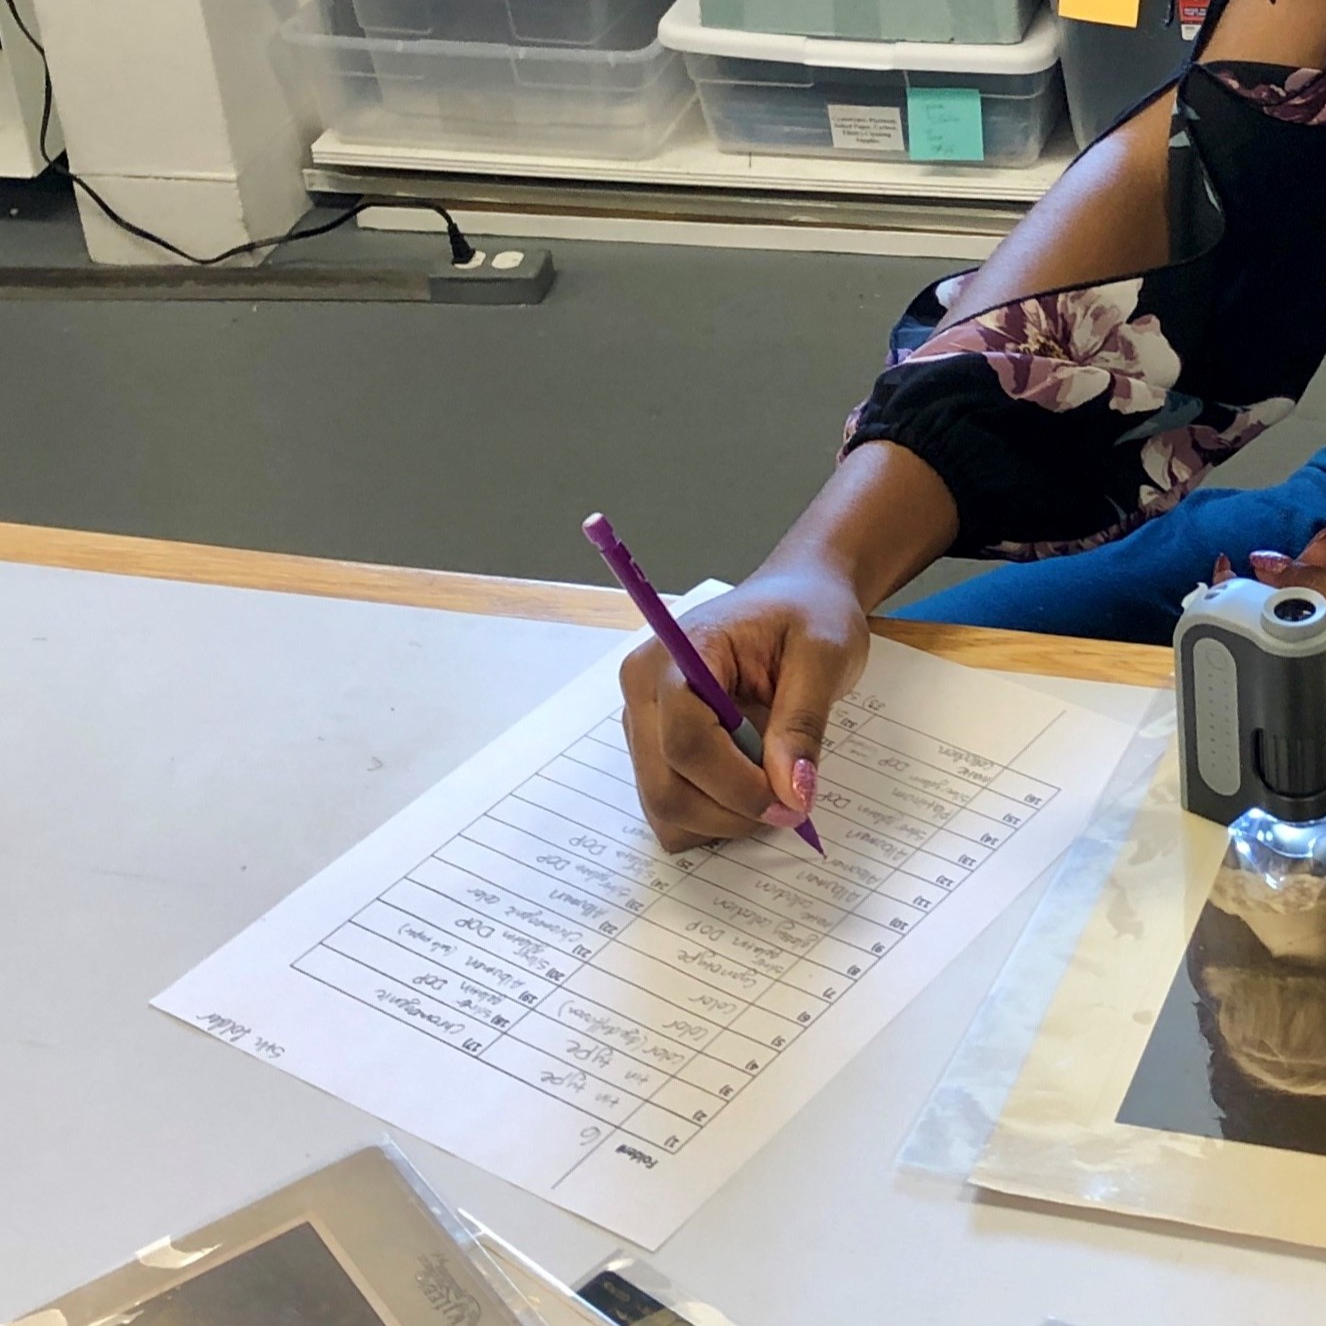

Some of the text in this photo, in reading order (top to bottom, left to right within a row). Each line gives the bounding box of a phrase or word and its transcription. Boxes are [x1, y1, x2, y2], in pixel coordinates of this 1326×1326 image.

[1024, 794, 1042, 805] 16)
[1002, 813, 1021, 824] 15)
[568, 834, 607, 856] DOP
[980, 832, 999, 845] 14)
[536, 854, 571, 871] DOP
[958, 854, 976, 866] 13)
[650, 878, 669, 890] 24)
[936, 874, 954, 887] 12)
[625, 898, 644, 912] 23)
[912, 896, 932, 908] 11)
[454, 918, 495, 938] DOP
[598, 920, 618, 935] 22)
[684, 920, 725, 941] DOP
[890, 918, 909, 930] 10)
[571, 944, 592, 958] 21)
[871, 942, 886, 953] 9)
[545, 967, 565, 982] 20)
[846, 965, 861, 976] 8)
[412, 973, 448, 990] DOP
[518, 990, 538, 1004] 19)
[822, 987, 836, 1000] 7)
[490, 1014, 510, 1028] 18)
[796, 1011, 811, 1023] 6)
[462, 1038, 483, 1053] 17)
[770, 1036, 786, 1047] 5)
[565, 1038, 613, 1069] type
[744, 1059, 759, 1071] 4)
[540, 1070, 586, 1094] type
[718, 1084, 734, 1097] 3)
[692, 1110, 708, 1122] 2)
[579, 1126, 601, 1146] 6
[664, 1135, 680, 1148] 1)
